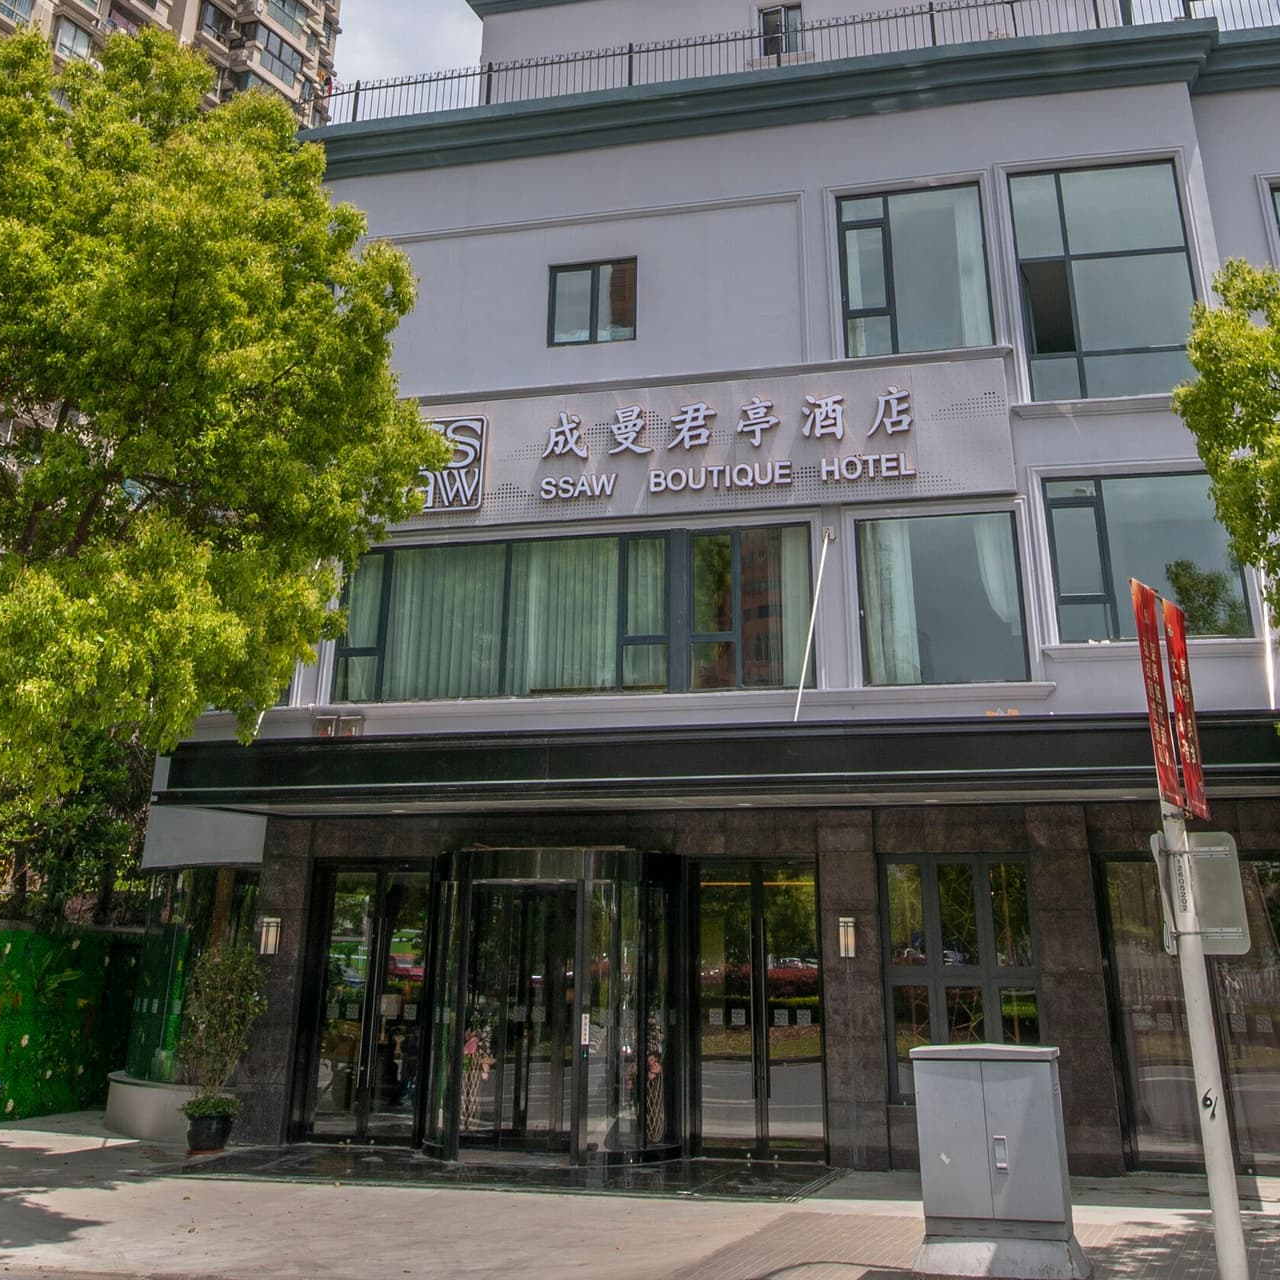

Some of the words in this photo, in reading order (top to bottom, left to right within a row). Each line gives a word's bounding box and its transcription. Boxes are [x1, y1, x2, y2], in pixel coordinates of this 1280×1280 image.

[540, 385, 915, 461] 成曼君亭酒店
[539, 472, 617, 501] SSAW
[648, 459, 792, 494] BOUTIQUE
[820, 452, 916, 483] HOTEL
